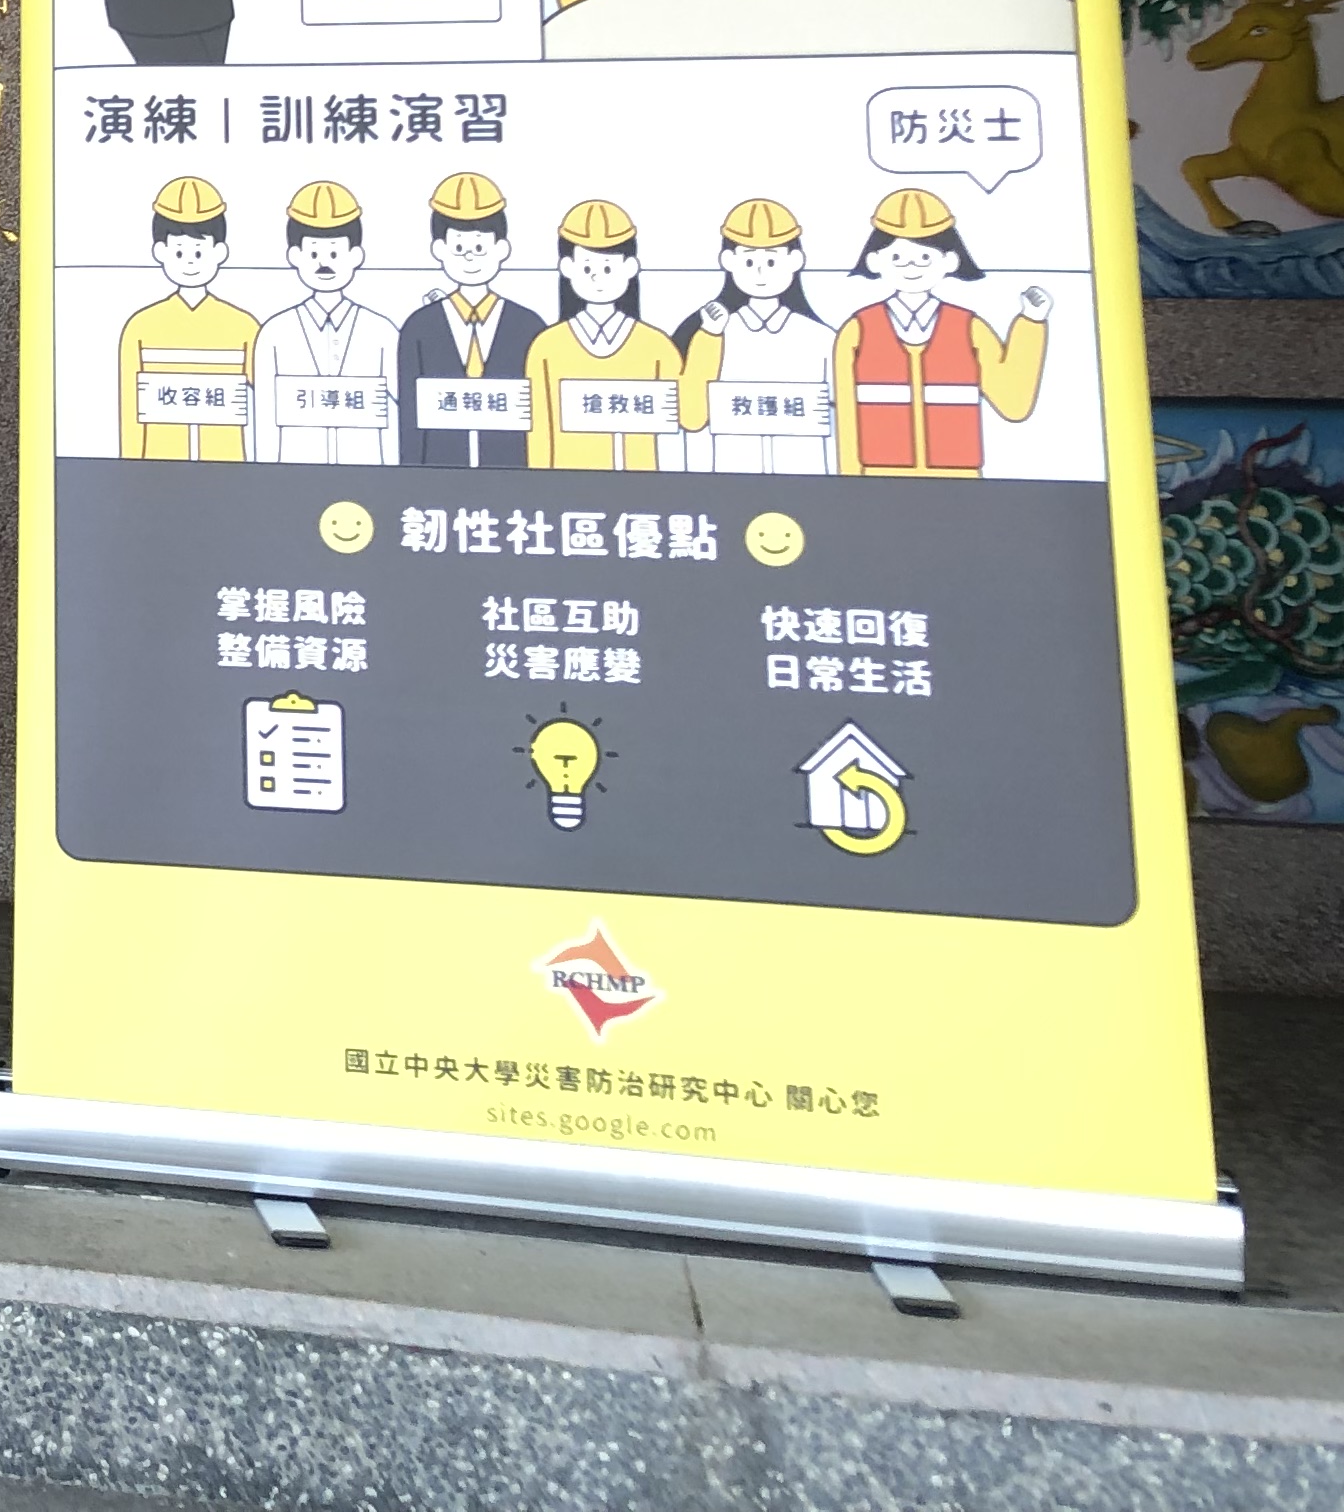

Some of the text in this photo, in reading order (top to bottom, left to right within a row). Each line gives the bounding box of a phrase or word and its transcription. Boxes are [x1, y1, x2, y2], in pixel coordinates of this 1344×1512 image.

[890, 107, 1022, 145] 防災士
[157, 386, 226, 407] 收容組
[296, 389, 365, 410] 引導組
[437, 391, 509, 413] 通報組
[582, 393, 655, 415] 搶救組
[731, 395, 806, 418] 救護組
[400, 506, 718, 561] 韌性社區優點
[216, 586, 366, 625] 掌握風險
[481, 595, 639, 636] 社區互助
[760, 605, 930, 648] 快速回復
[217, 631, 368, 673] 整備資源
[484, 642, 641, 684] 災害應變
[766, 654, 932, 697] 日常生活
[551, 969, 646, 994] RCHMP
[344, 1047, 881, 1118] 國立中央大學災害防治研究中心 關心您
[486, 1103, 717, 1142] sites.google.com
